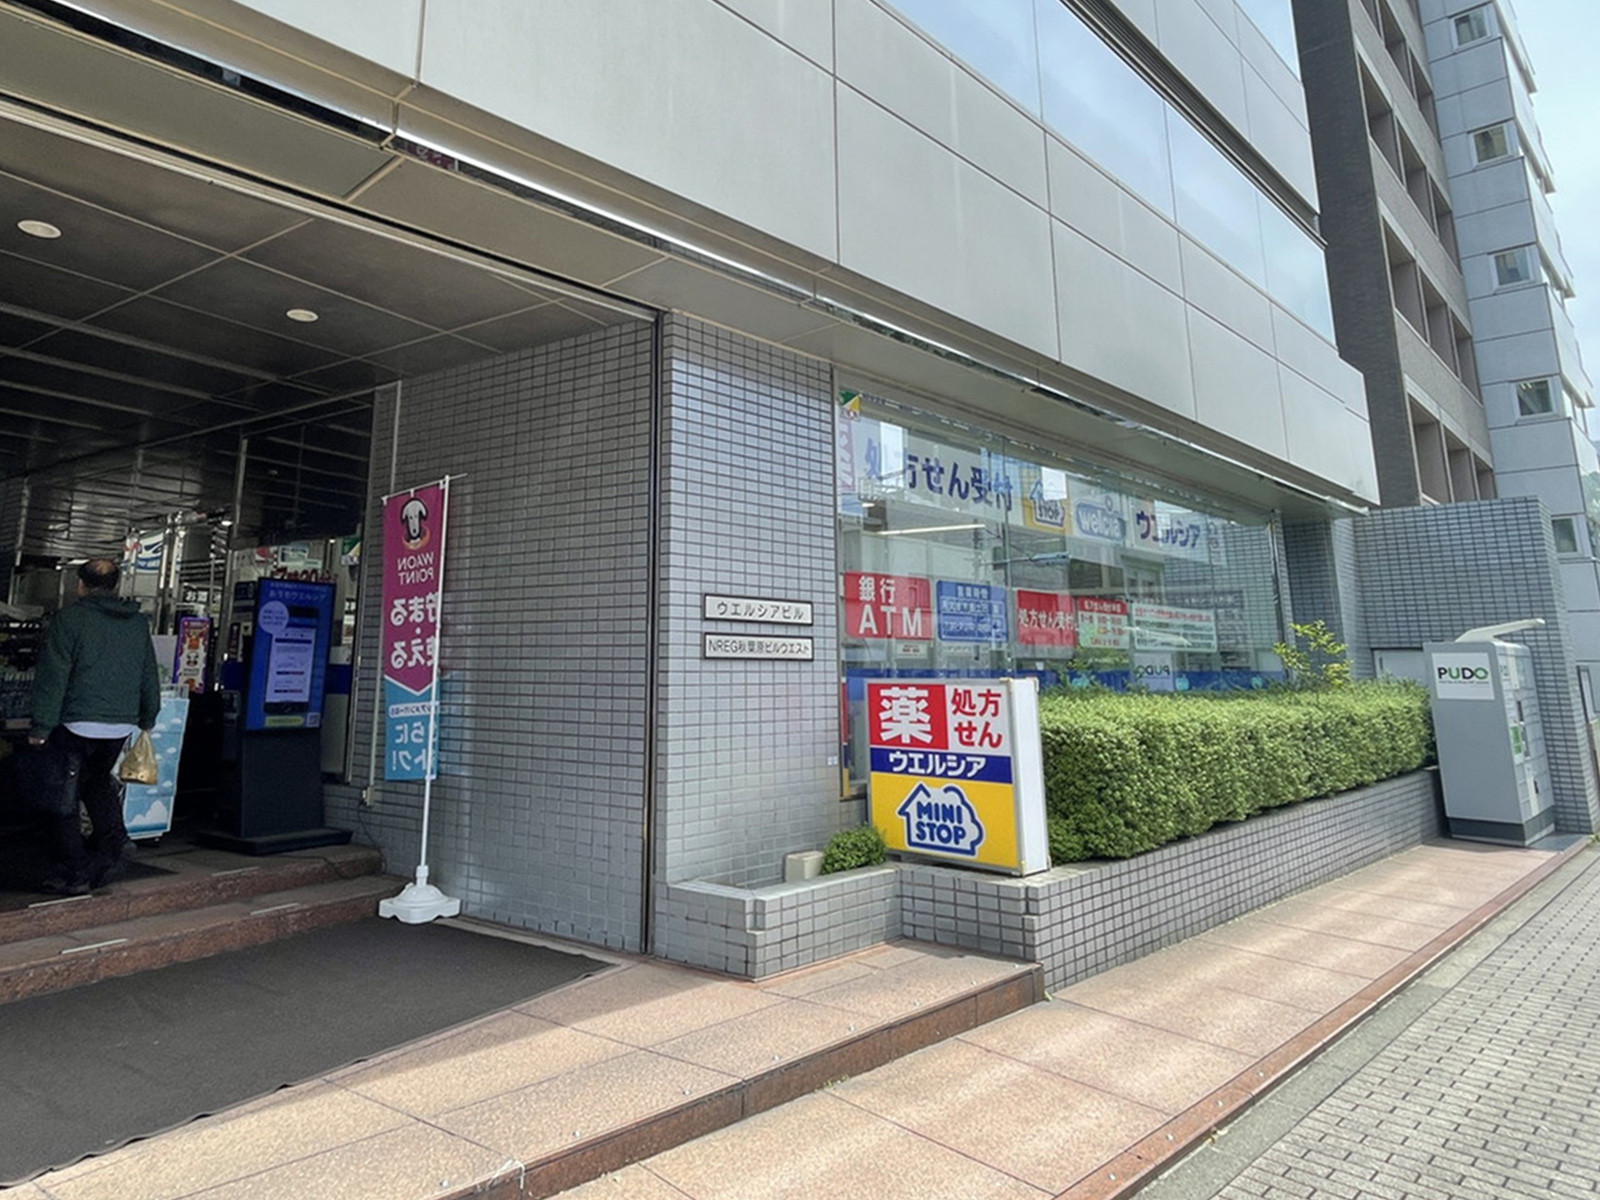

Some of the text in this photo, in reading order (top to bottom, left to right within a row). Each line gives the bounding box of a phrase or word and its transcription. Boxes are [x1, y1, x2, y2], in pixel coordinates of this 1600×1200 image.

[1078, 508, 1122, 538] welcia
[858, 575, 897, 605] 銀行
[716, 602, 805, 622] ウエルシアビル
[859, 604, 923, 637] ATM
[708, 638, 811, 657] NREG秋葉原ビルウエスト
[1437, 666, 1489, 680] PUDO
[878, 686, 933, 745] 薬
[951, 688, 1002, 717] 処方
[954, 720, 1003, 749] せん
[888, 751, 986, 777] ウエルシア
[916, 799, 963, 824] MINI
[915, 821, 966, 846] STOP
